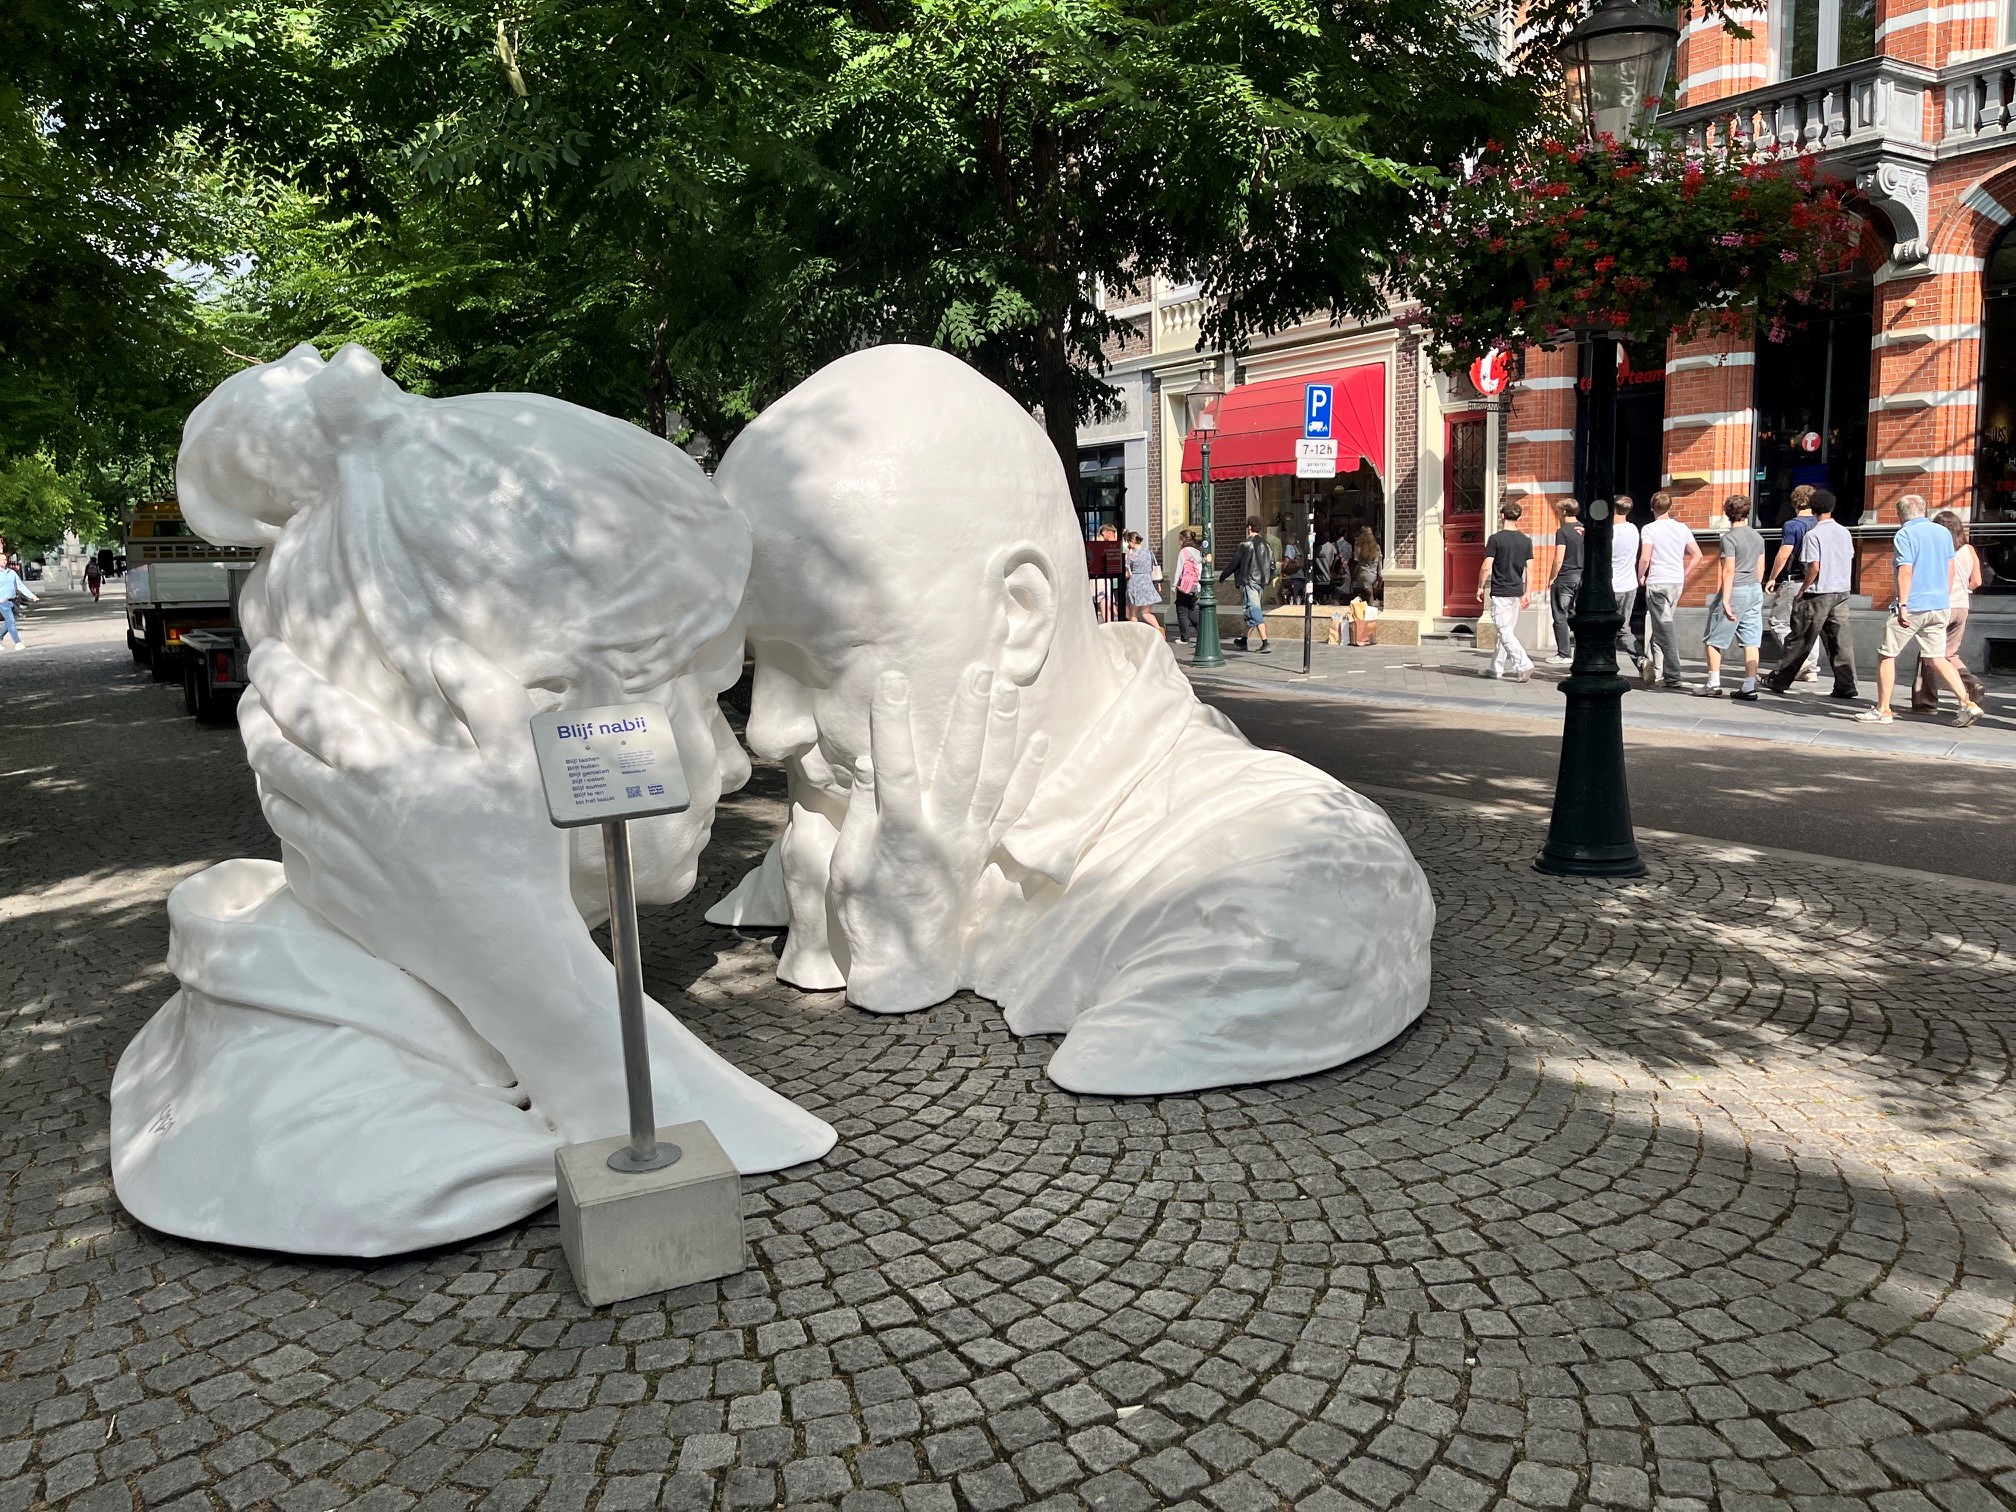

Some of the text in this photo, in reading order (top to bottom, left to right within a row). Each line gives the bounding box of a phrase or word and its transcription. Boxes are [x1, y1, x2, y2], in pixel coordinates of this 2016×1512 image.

[1312, 389, 1328, 417] P
[1303, 444, 1333, 455] 7-12h
[557, 717, 647, 740] Blijf nabij
[582, 769, 610, 777] genieten
